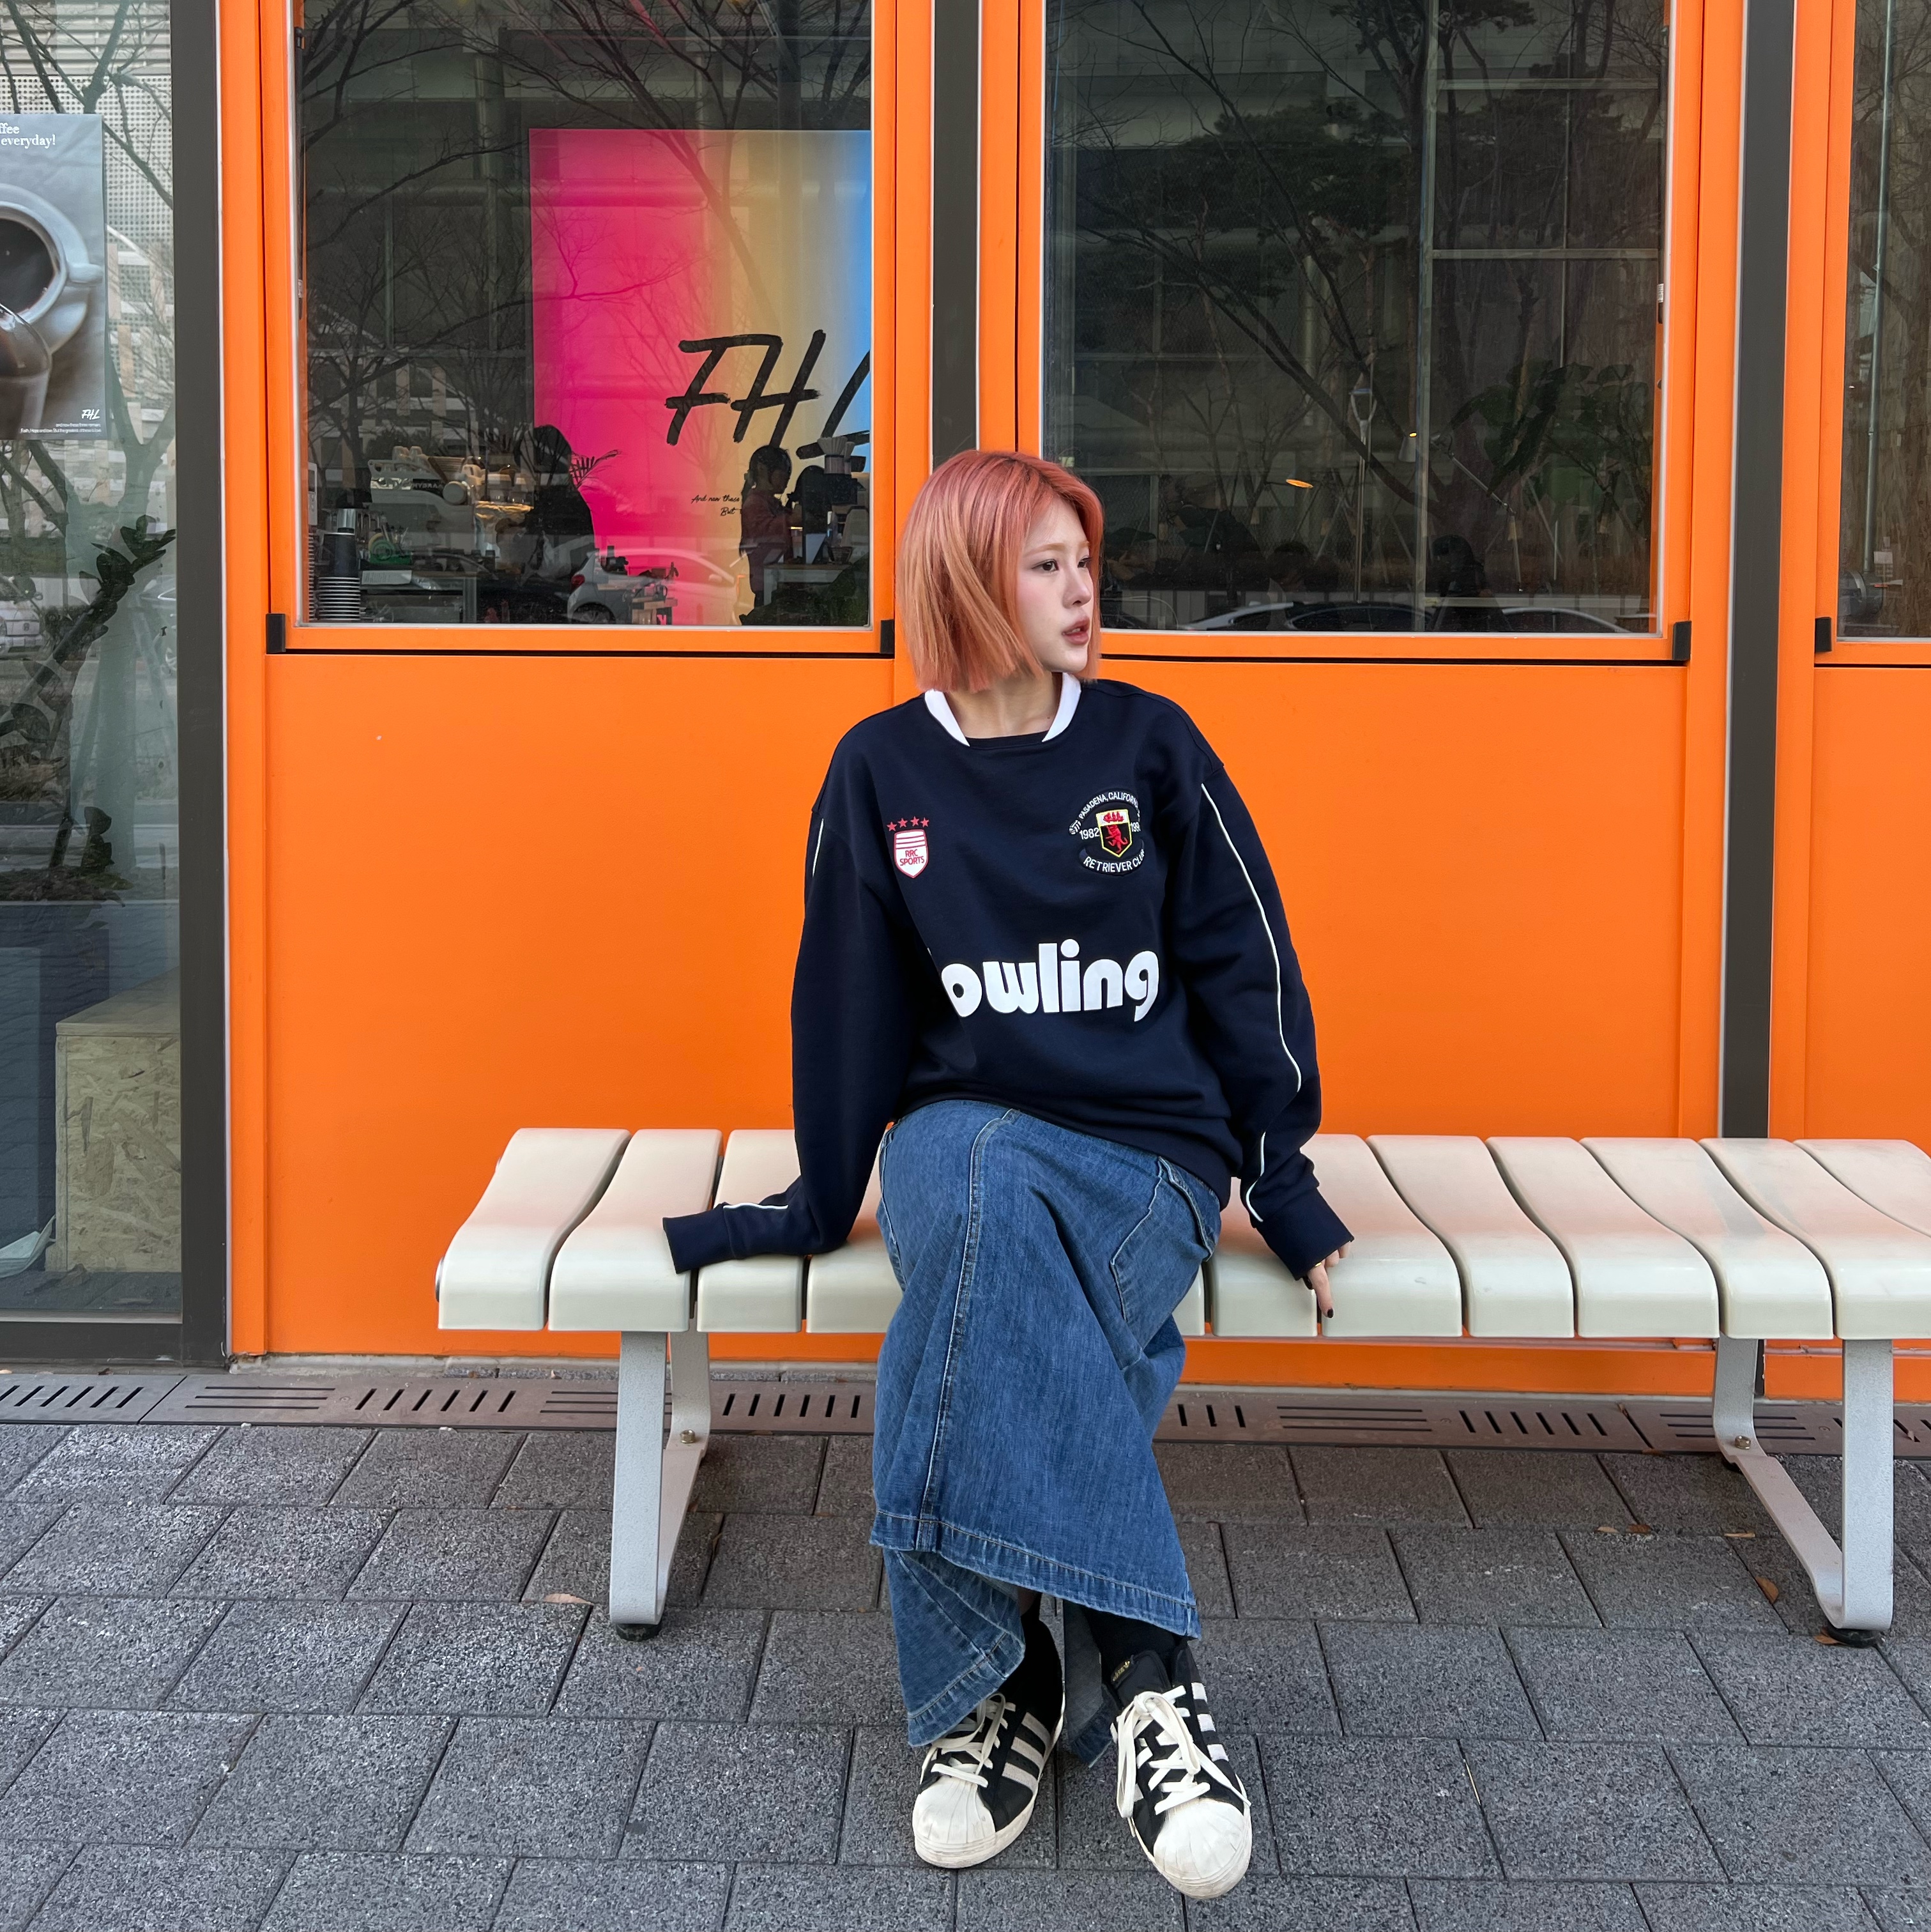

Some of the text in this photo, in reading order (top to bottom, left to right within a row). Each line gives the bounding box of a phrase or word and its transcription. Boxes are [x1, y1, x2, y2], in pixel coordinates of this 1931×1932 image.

[1, 134, 56, 149] everyday!
[81, 409, 100, 420] FHL
[691, 494, 706, 504] And
[721, 507, 736, 516] But
[1079, 793, 1109, 819] PASADENA,
[1080, 827, 1100, 839] 1982
[900, 856, 924, 866] SPORTS
[1083, 856, 1133, 872] RETRIEVER
[927, 938, 1159, 1022] owling
